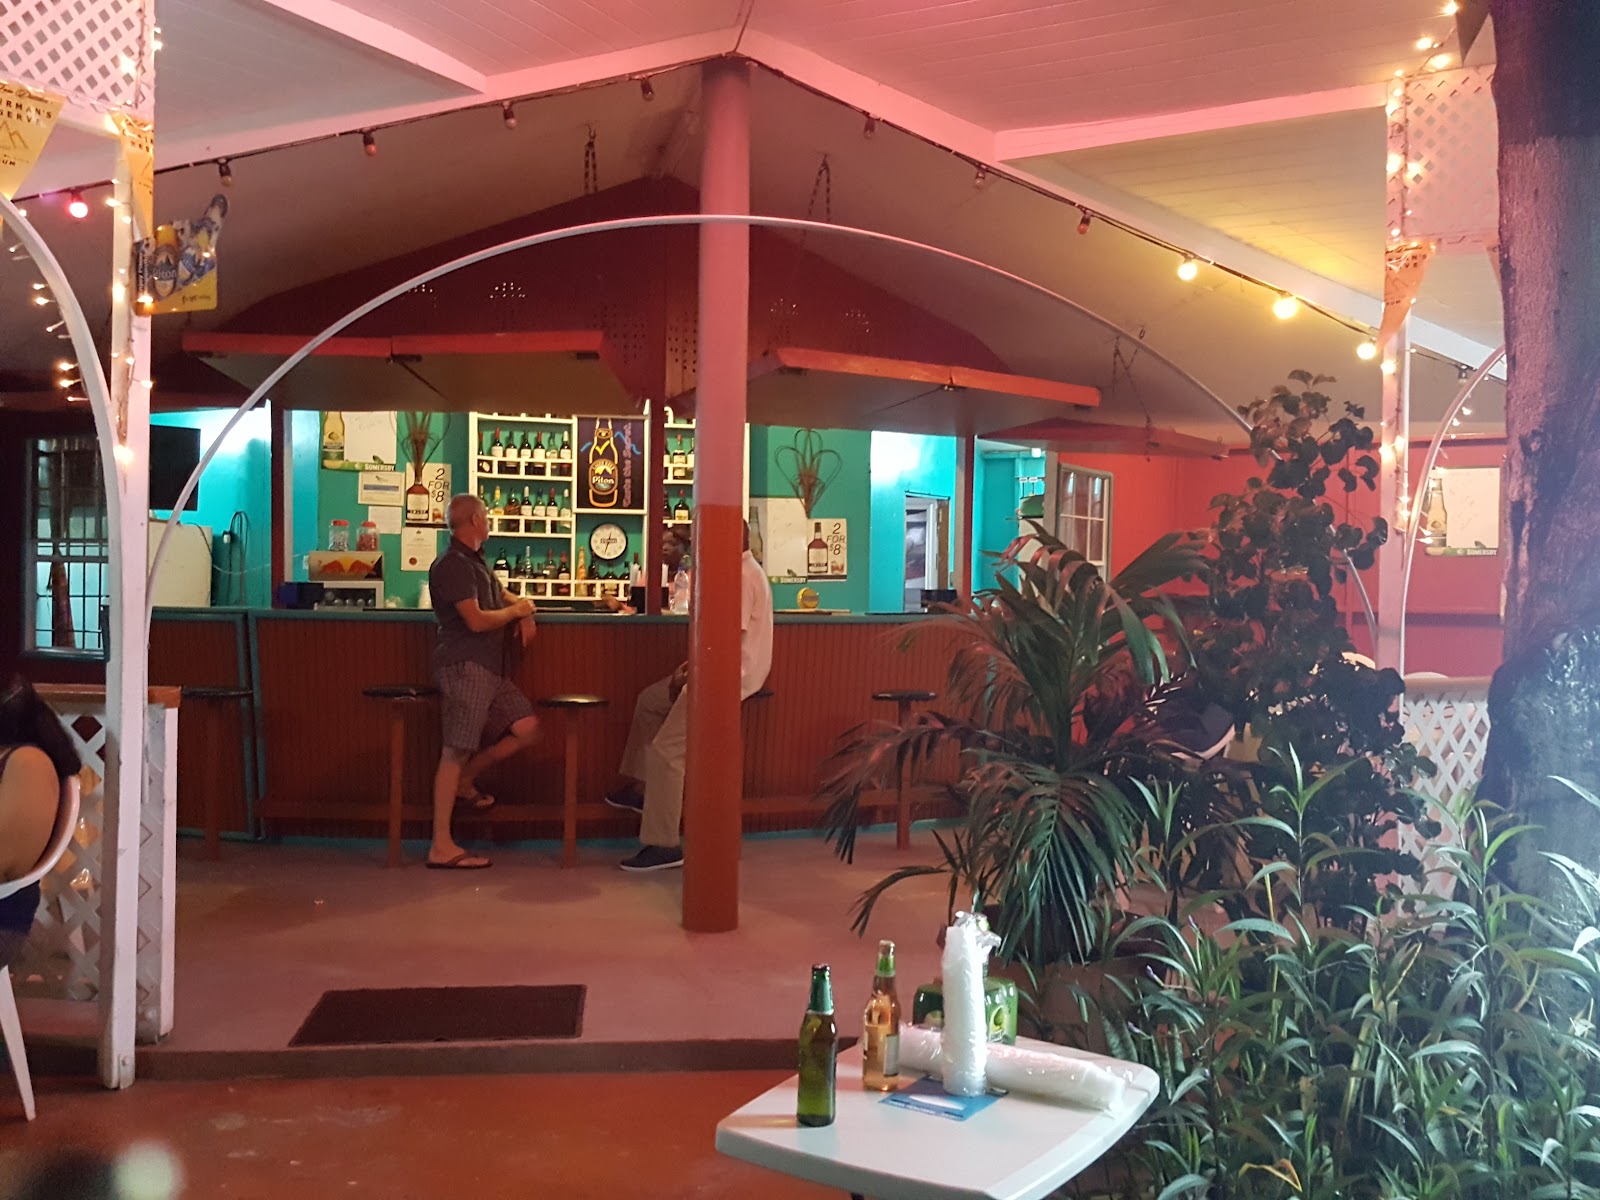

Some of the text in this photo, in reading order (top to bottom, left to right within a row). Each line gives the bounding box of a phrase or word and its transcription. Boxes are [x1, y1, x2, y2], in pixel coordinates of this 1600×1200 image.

[435, 468, 445, 480] 2
[428, 481, 450, 490] FOR
[431, 490, 445, 503] $8
[832, 522, 842, 535] 2
[826, 535, 846, 543] FOR
